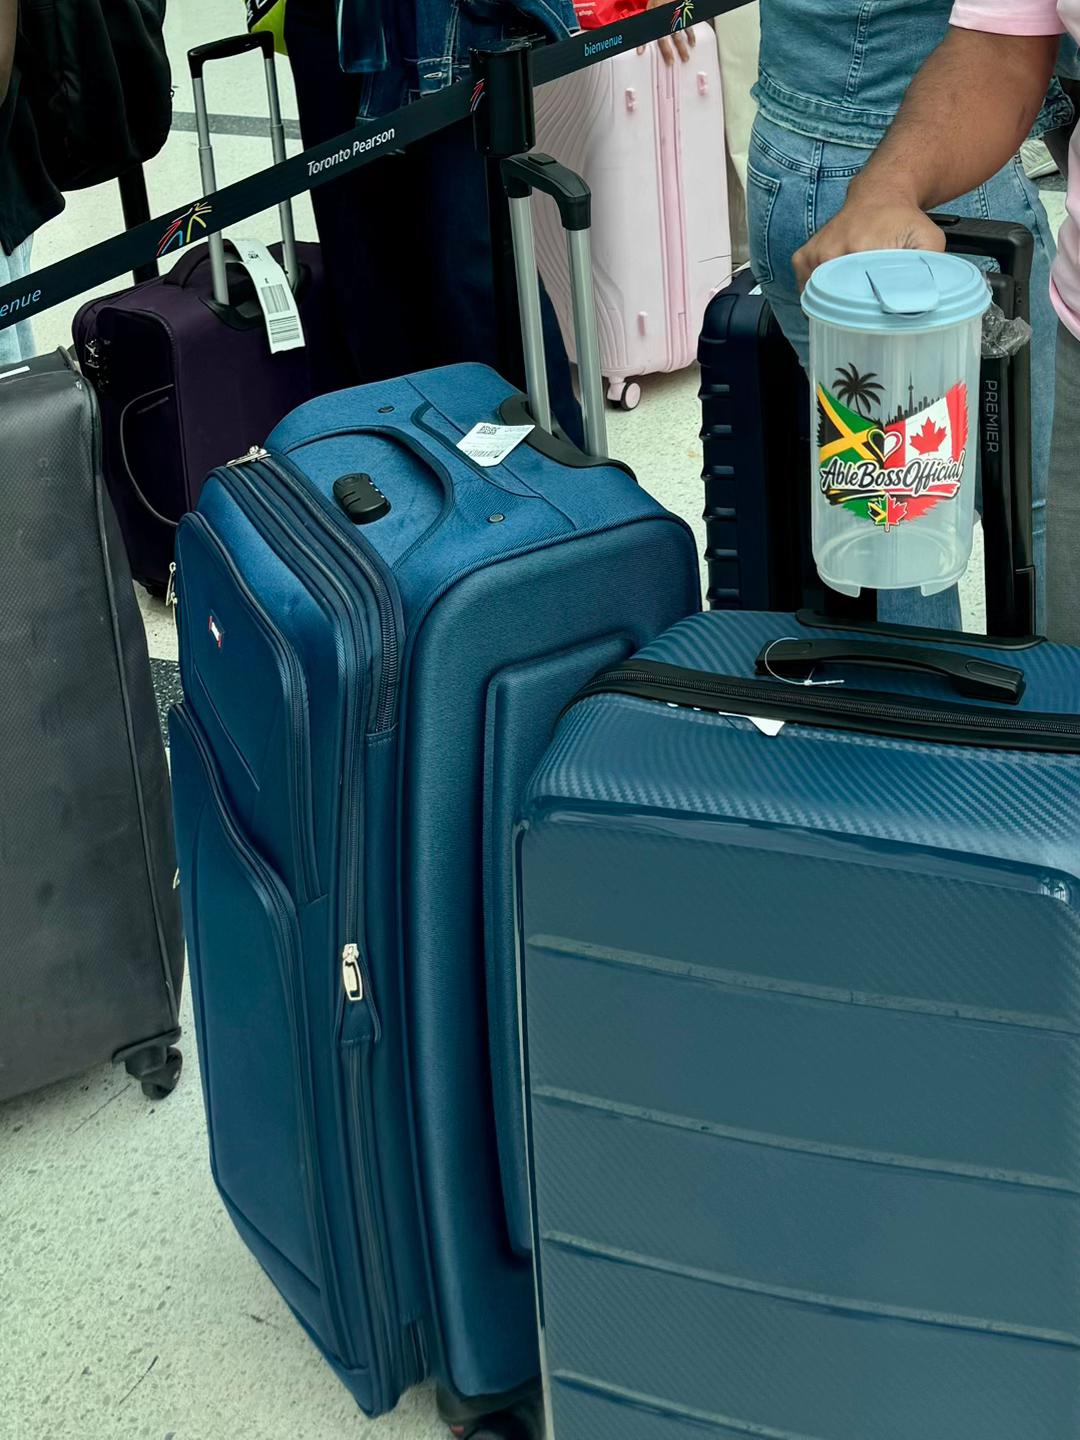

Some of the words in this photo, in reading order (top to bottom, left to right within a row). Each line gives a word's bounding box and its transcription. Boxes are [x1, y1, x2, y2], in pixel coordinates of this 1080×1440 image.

[584, 33, 624, 57] bienvenue
[307, 148, 351, 176] Toronto
[352, 128, 395, 157] Pearson
[985, 380, 1000, 453] PREMIER
[821, 451, 964, 495] AbleBossOfficial
